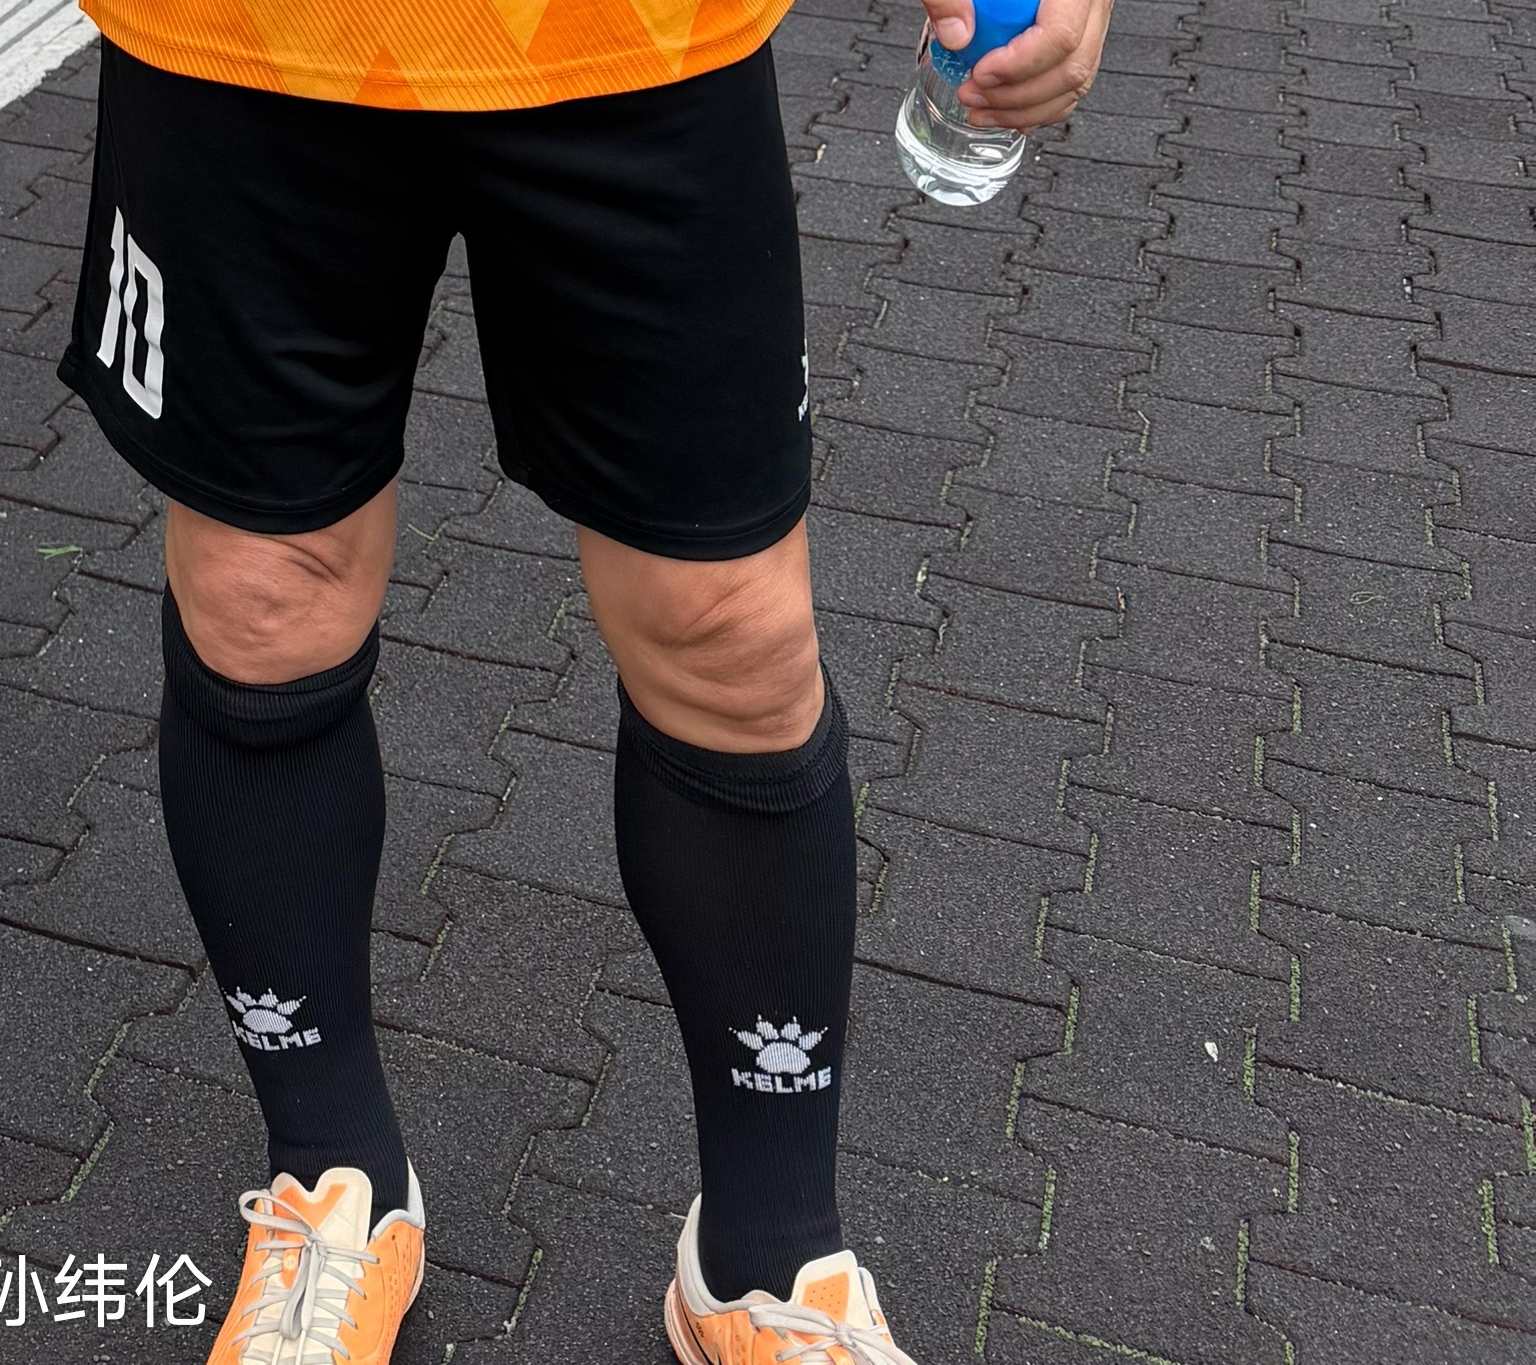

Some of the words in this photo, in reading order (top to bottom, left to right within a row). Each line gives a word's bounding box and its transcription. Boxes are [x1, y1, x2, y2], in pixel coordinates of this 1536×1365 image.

[96, 205, 164, 419] 10
[232, 1020, 321, 1051] KELME
[731, 1066, 832, 1094] KELME
